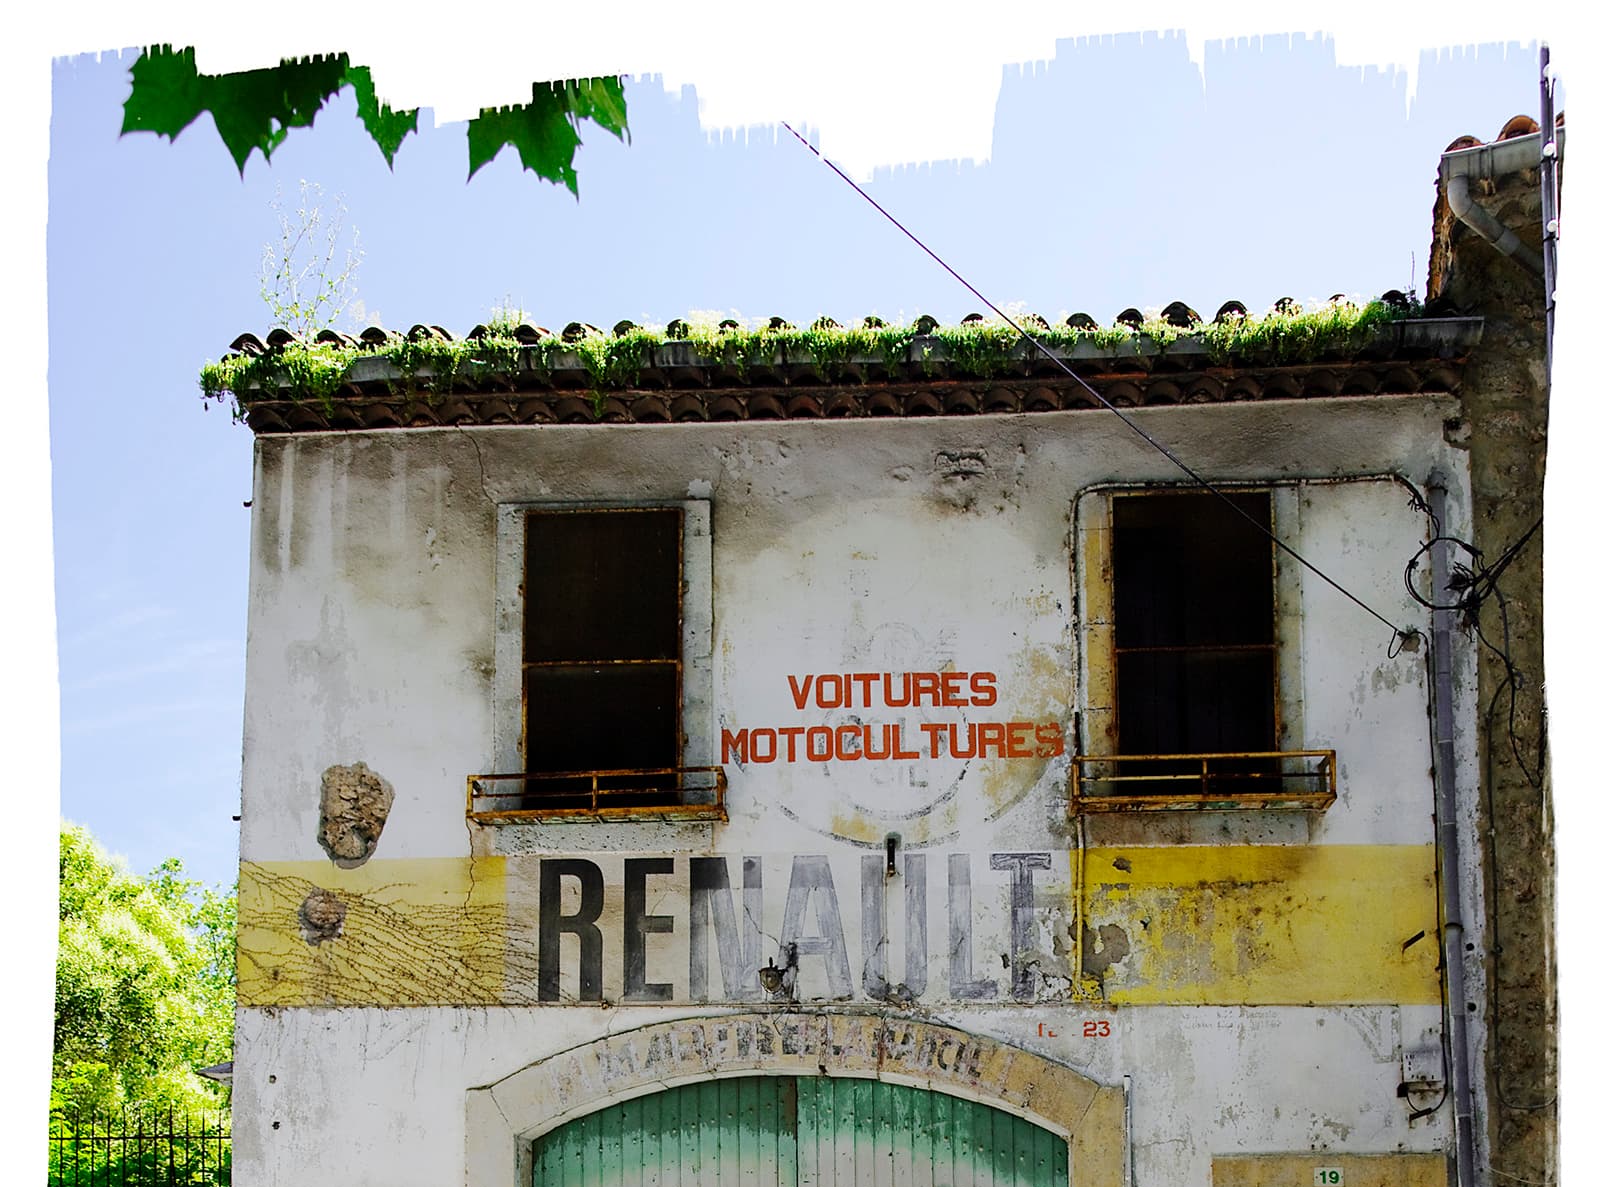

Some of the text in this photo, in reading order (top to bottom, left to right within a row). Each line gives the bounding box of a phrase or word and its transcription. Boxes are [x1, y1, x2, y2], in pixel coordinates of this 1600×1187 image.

[788, 671, 997, 710] VOITURES
[720, 722, 1064, 765] MOTOCULTURES
[538, 853, 1052, 1003] RENAULT
[1083, 1020, 1111, 1038] 23
[1319, 1170, 1340, 1185] 19
